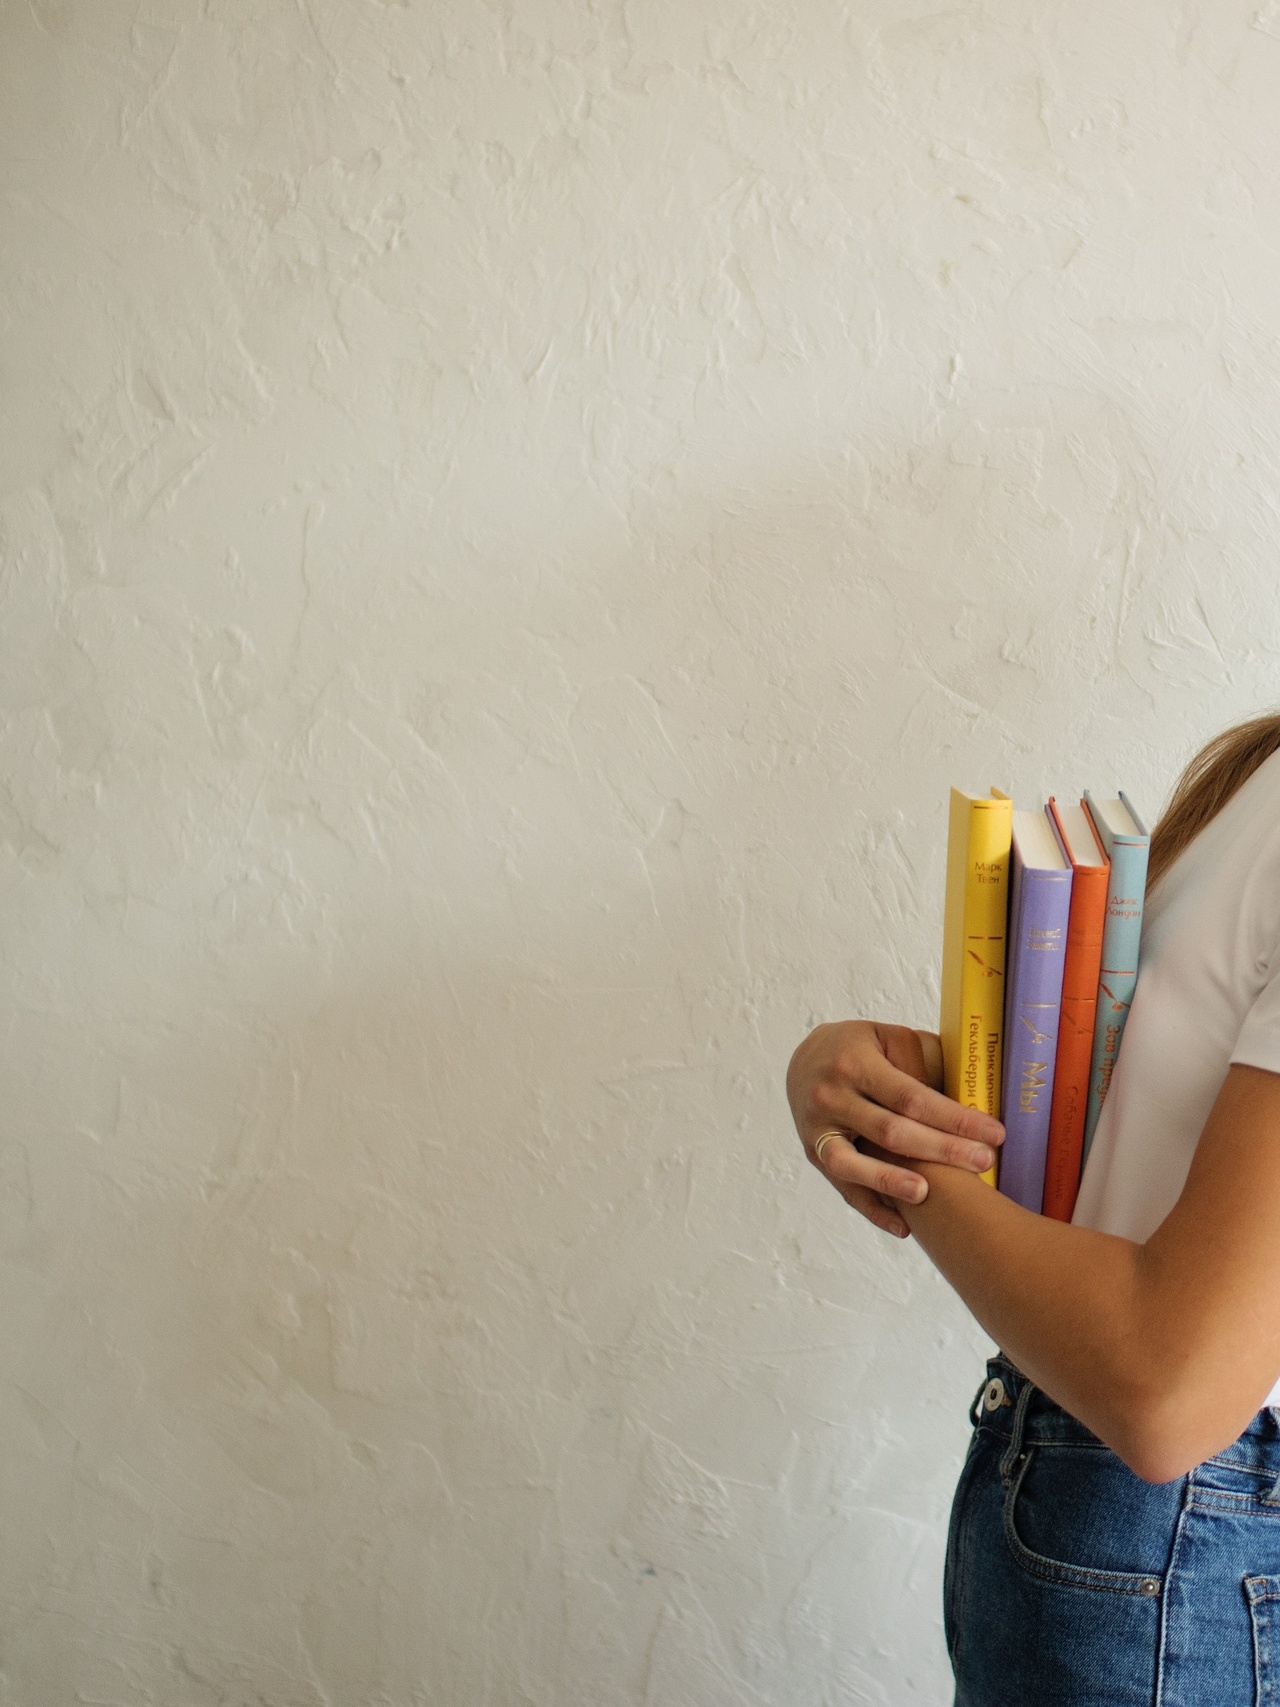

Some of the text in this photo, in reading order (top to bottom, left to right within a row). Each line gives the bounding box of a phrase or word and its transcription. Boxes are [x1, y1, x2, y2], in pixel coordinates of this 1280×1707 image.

[974, 862, 1003, 873] Марк
[976, 873, 1000, 884] Твен
[1110, 896, 1138, 906] Джек
[1104, 1024, 1121, 1054] Зов
[965, 1015, 983, 1098] Гекльберри
[1019, 1059, 1048, 1113] Мы
